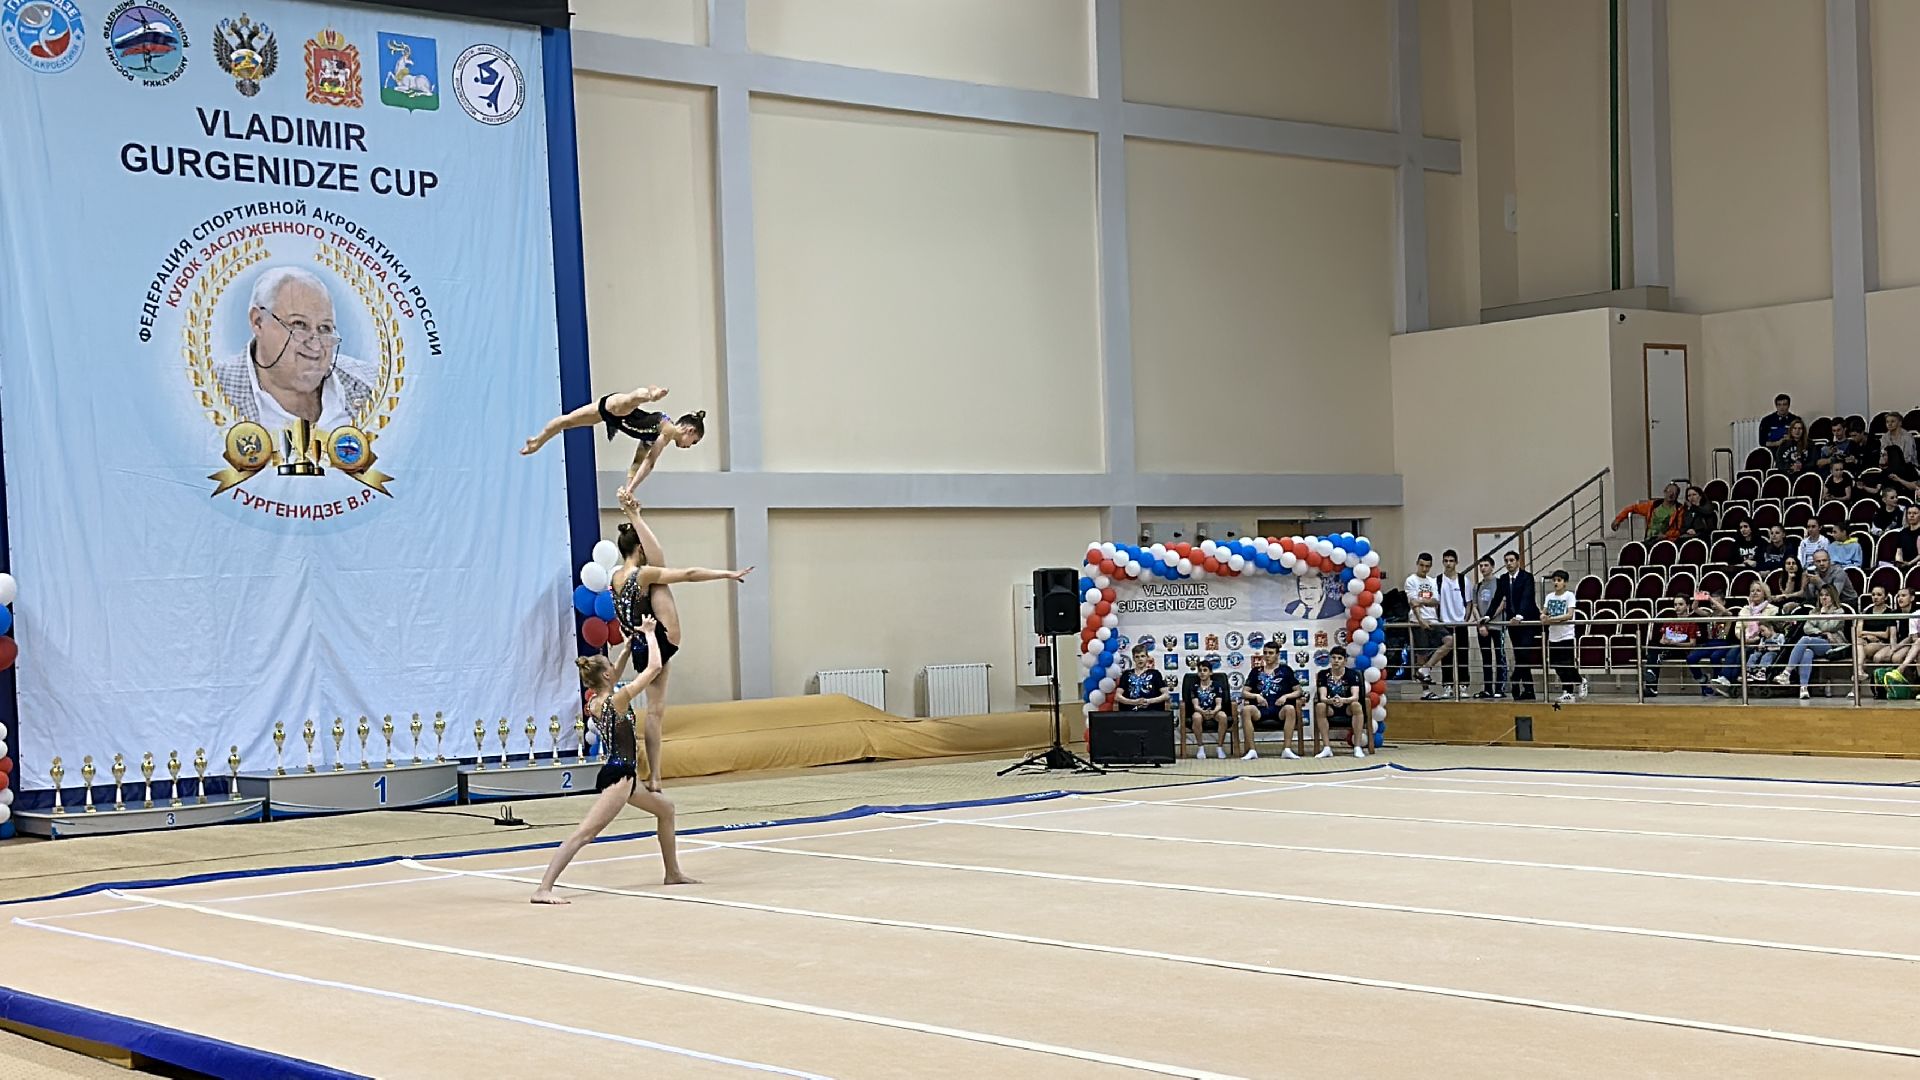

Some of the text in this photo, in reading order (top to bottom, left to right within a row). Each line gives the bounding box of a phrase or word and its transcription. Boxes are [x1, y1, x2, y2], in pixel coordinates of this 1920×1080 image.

[106, 46, 135, 82] РОССИИ
[196, 107, 367, 152] VLADIMIR
[120, 143, 438, 197] GURGENIDZE CUP
[138, 199, 443, 356] ФЕДЕРАЦИЯ СПОРТИВНОЙ АКРОБАТИКИ РОССИИ
[165, 221, 415, 319] КУБОК ЗАСЛУЖЕННОГО ТРЕНЕРА СССР
[232, 488, 376, 521] ГУРГЕНИДЗЕ В.Р.
[1117, 597, 1237, 613] GURGENIDZE CUP
[1142, 584, 1209, 597] VLADIMIR
[373, 775, 389, 805] 1
[561, 771, 574, 789] 2
[166, 812, 176, 826] 3
